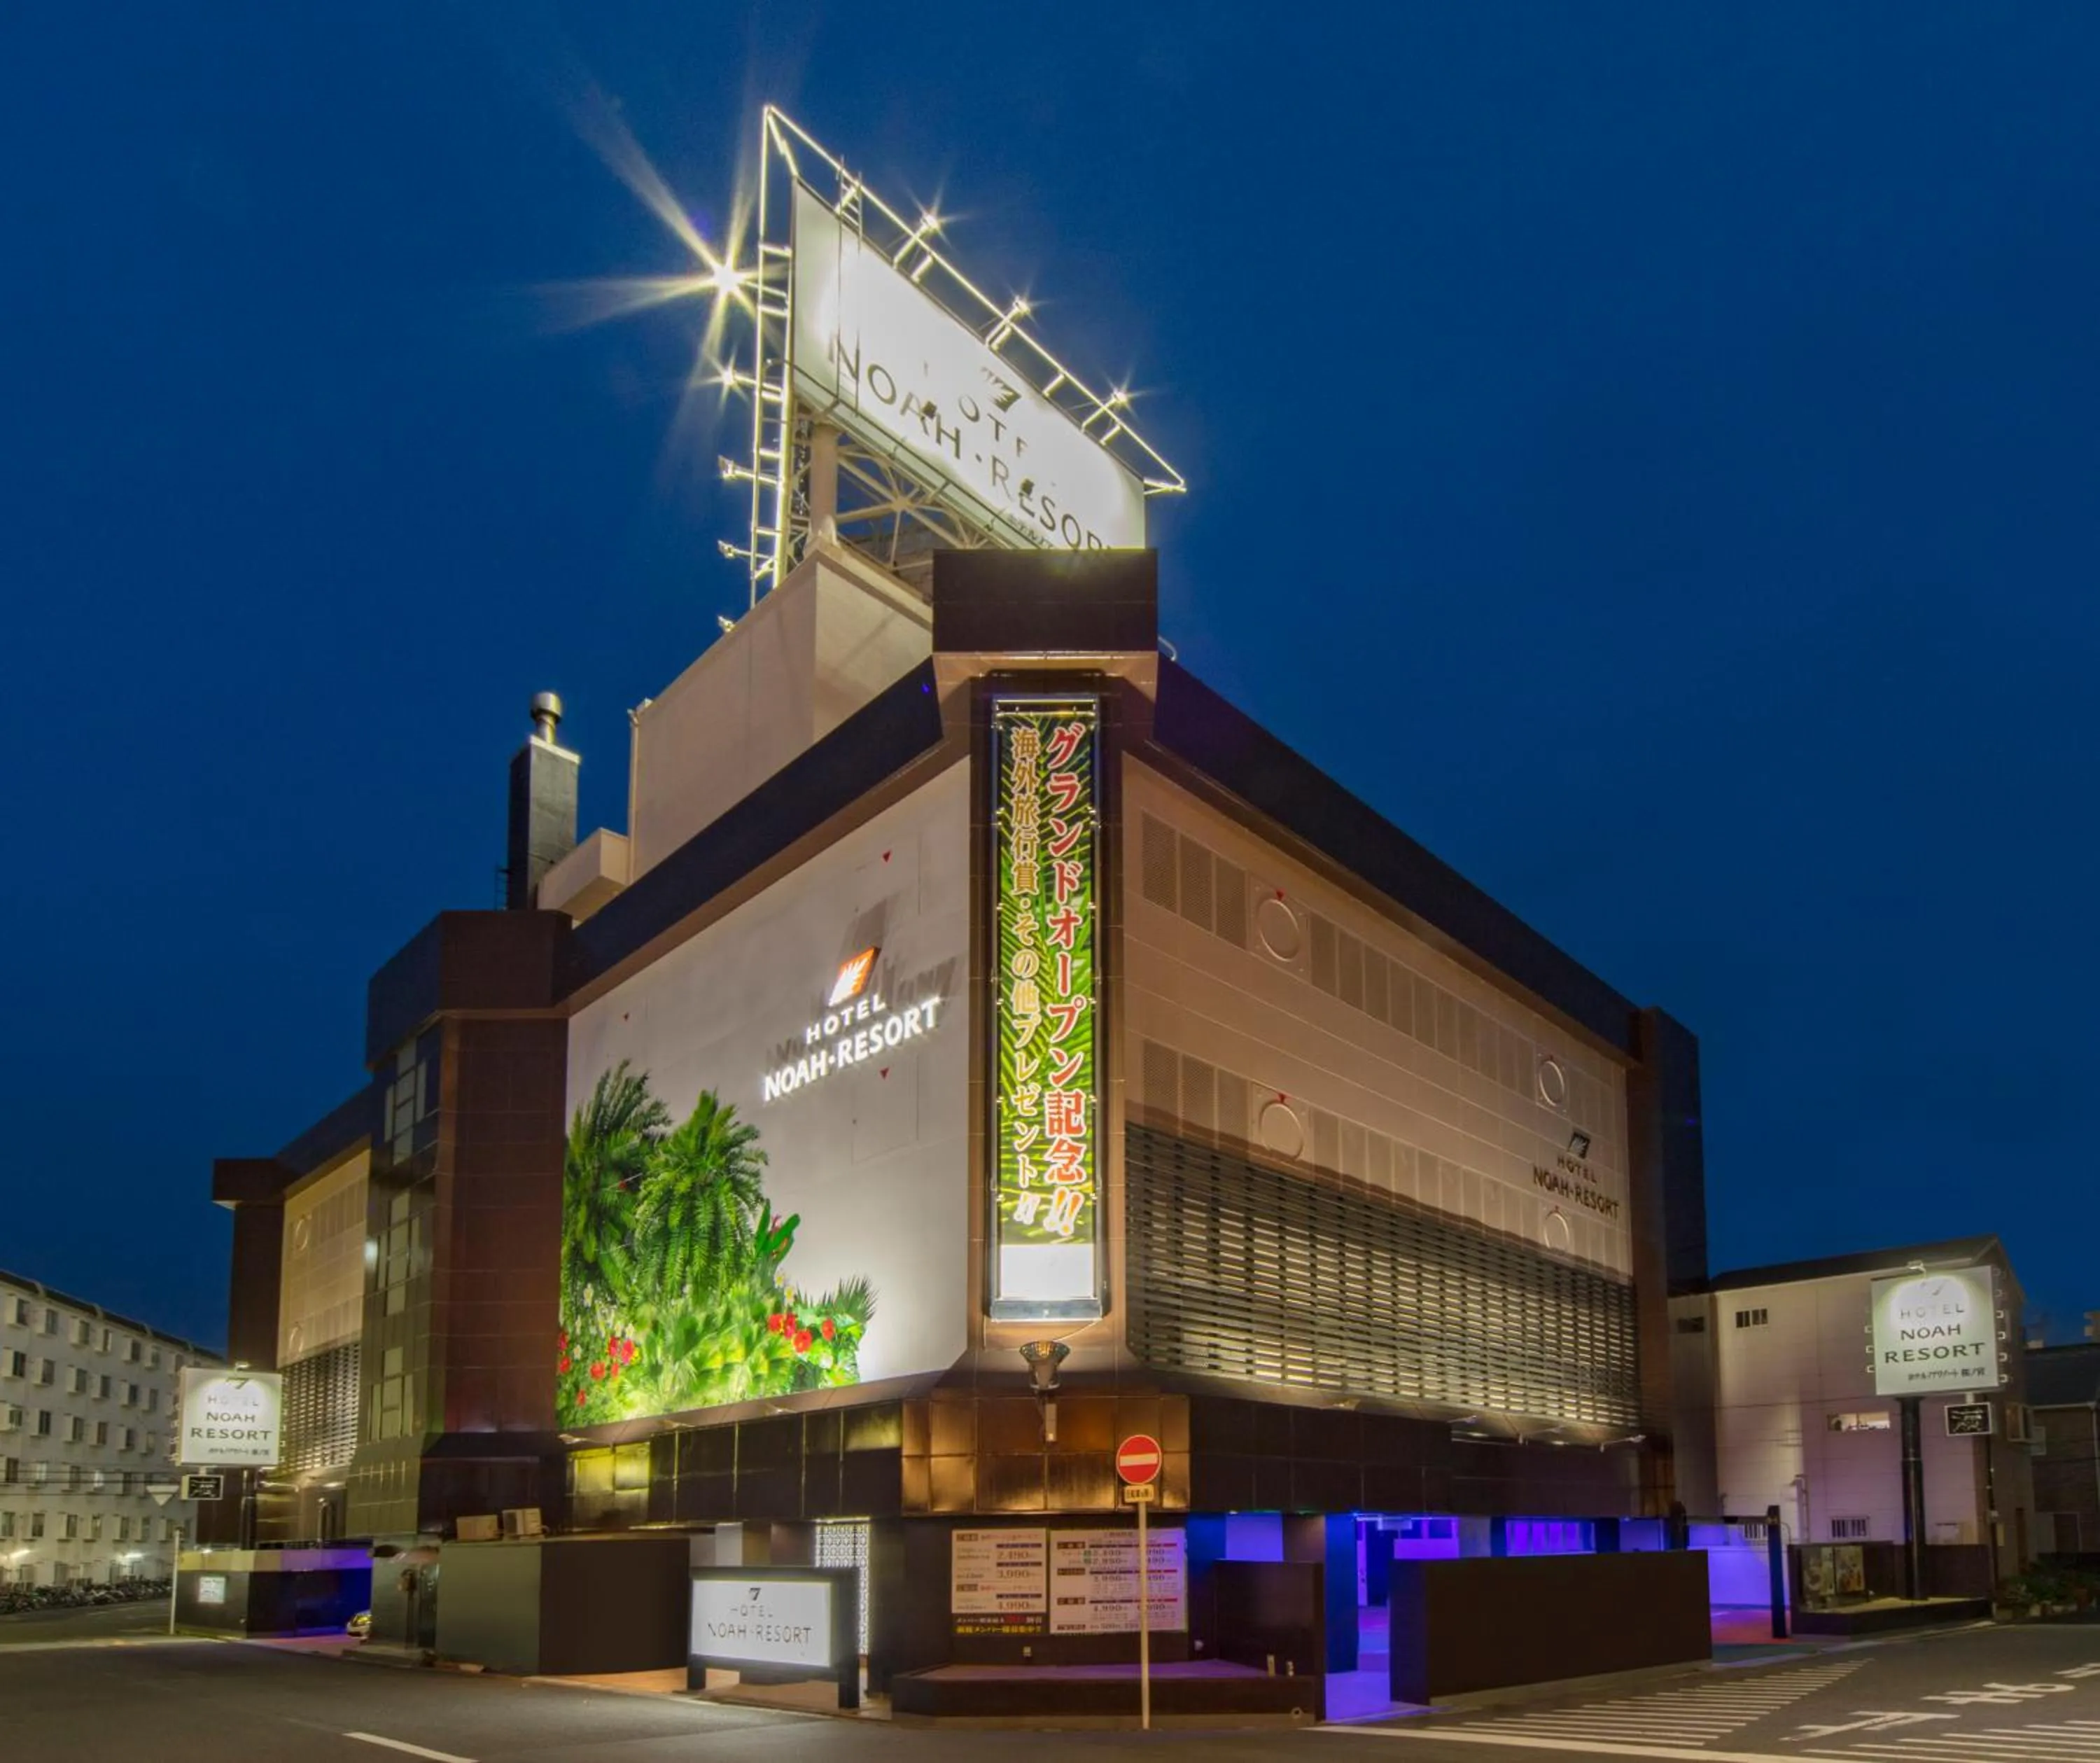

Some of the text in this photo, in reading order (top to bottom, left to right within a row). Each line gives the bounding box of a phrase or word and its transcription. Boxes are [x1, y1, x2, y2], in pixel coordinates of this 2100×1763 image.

[806, 993, 887, 1045] HOTEL
[1557, 1156, 1597, 1184] HOTEL
[1900, 1303, 1965, 1319] HOEL
[1900, 1324, 1961, 1341] NOAH
[1885, 1342, 1985, 1363] RESORT
[206, 1412, 255, 1423] NOAH
[191, 1428, 272, 1440] RESORT
